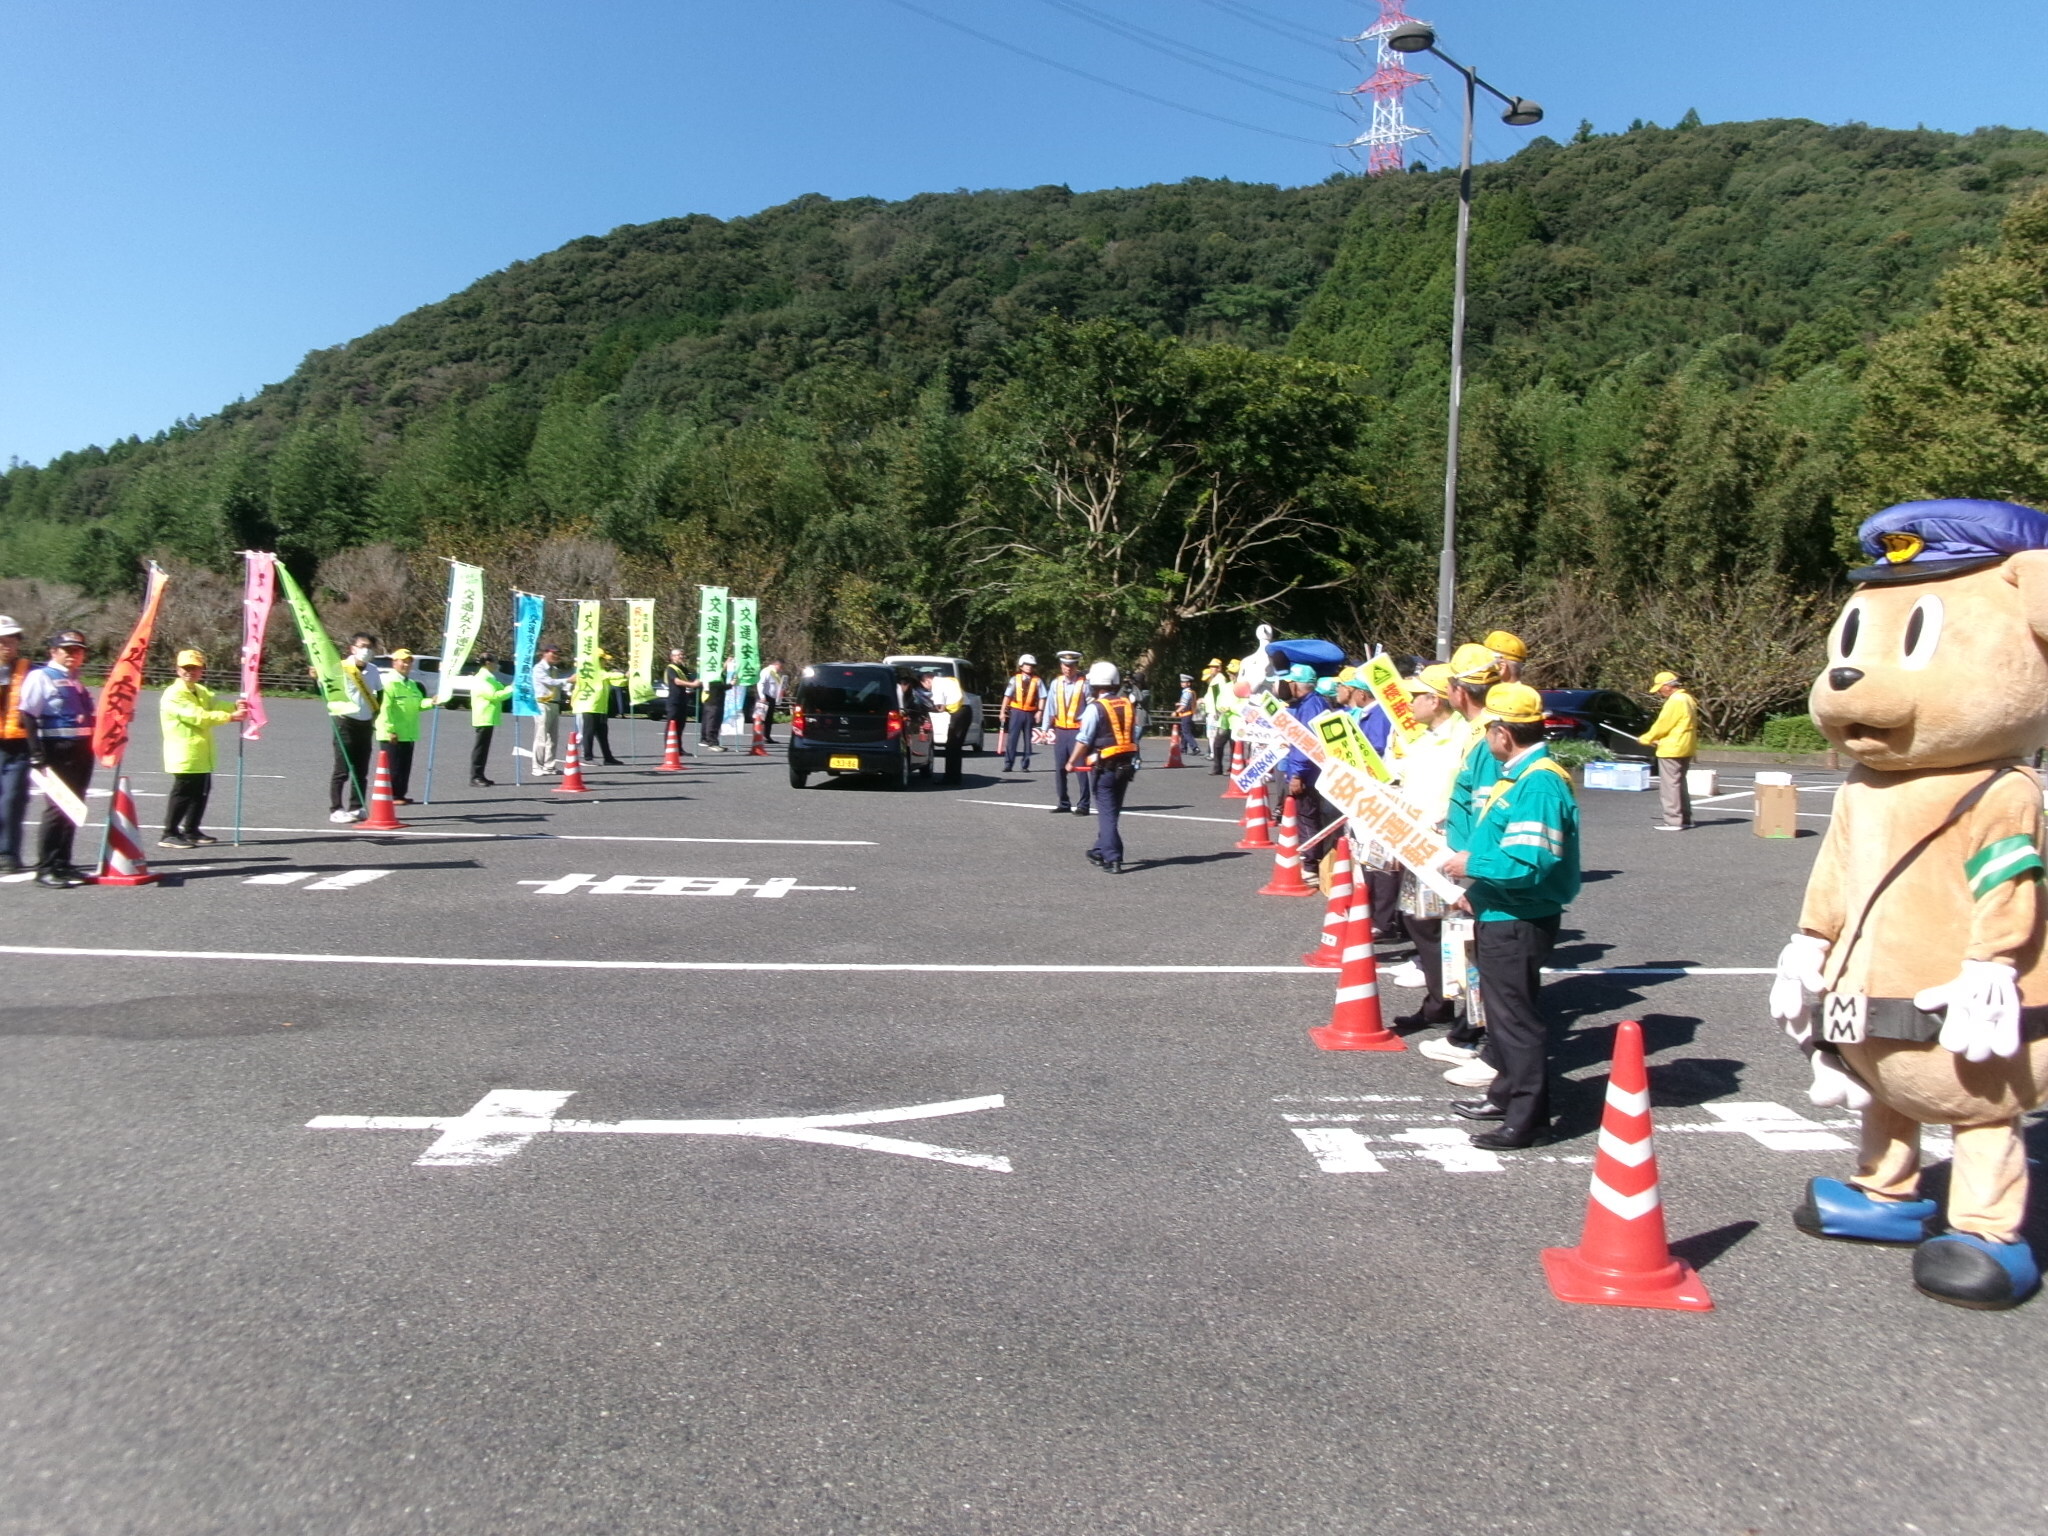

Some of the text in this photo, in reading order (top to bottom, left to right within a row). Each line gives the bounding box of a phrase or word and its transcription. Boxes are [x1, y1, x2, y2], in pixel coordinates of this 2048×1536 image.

[706, 596, 722, 672] 交通安全
[739, 606, 756, 677] 交通安全
[1327, 764, 1440, 867] 安全運転
